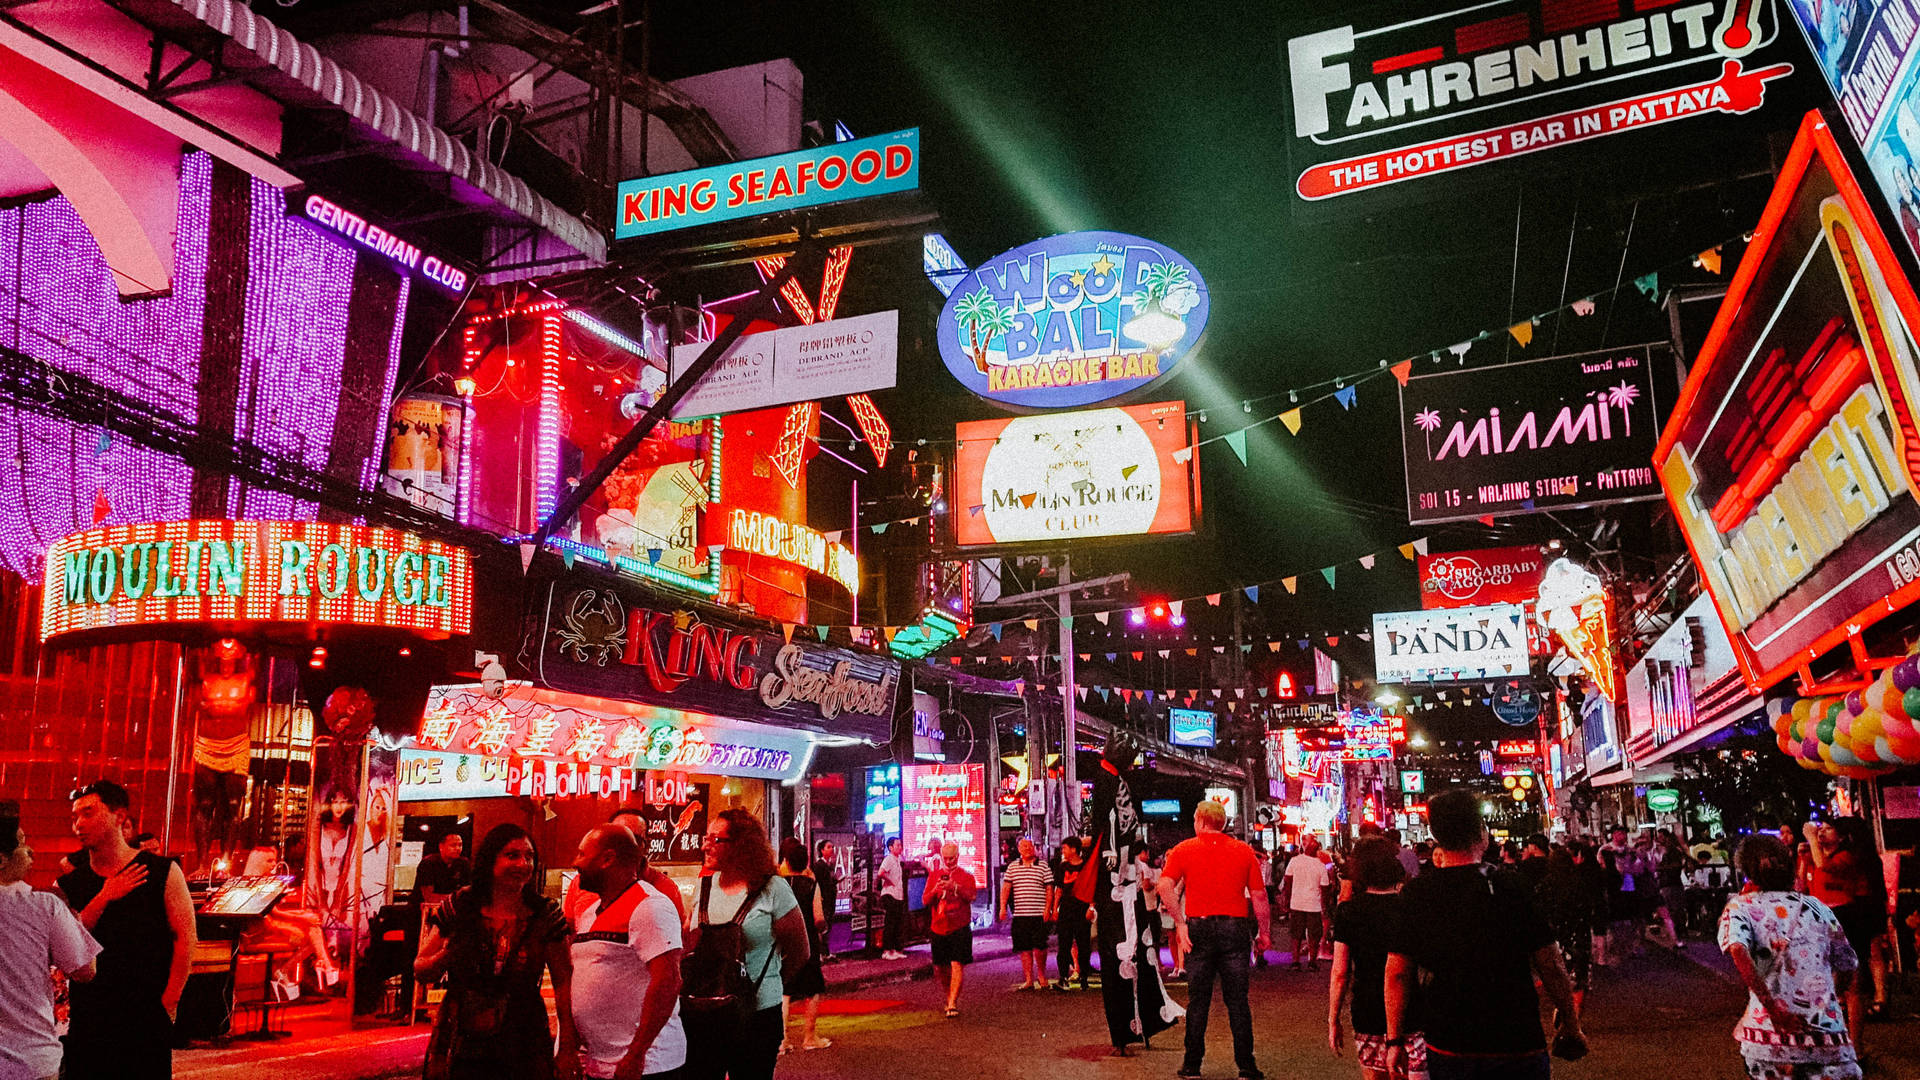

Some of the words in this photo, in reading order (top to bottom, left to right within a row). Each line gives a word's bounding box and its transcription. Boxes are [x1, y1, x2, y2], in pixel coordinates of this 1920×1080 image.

[1288, 4, 1714, 137] FAHRENHEIT
[1329, 163, 1379, 187] THE
[1385, 135, 1503, 176] HOTTEST
[1511, 121, 1566, 150] BAR
[1573, 112, 1601, 137] IN
[1609, 85, 1732, 129] PATTAYA
[623, 179, 718, 225] KING
[727, 144, 913, 208] SEAFOOD
[305, 194, 422, 270] GENTLEMAN
[422, 255, 468, 292] CLUB
[987, 360, 1103, 392] KARAOKE
[1108, 352, 1161, 380] BAR
[1435, 391, 1612, 462] MIAMI
[1419, 493, 1438, 509] SOI
[1445, 489, 1461, 507] 15
[62, 540, 247, 607] MOULIN
[278, 540, 451, 609] ROUGE
[1453, 574, 1512, 590] AGO-GO
[1455, 561, 1539, 580] SUGARBABY
[1388, 628, 1512, 656] PANDA
